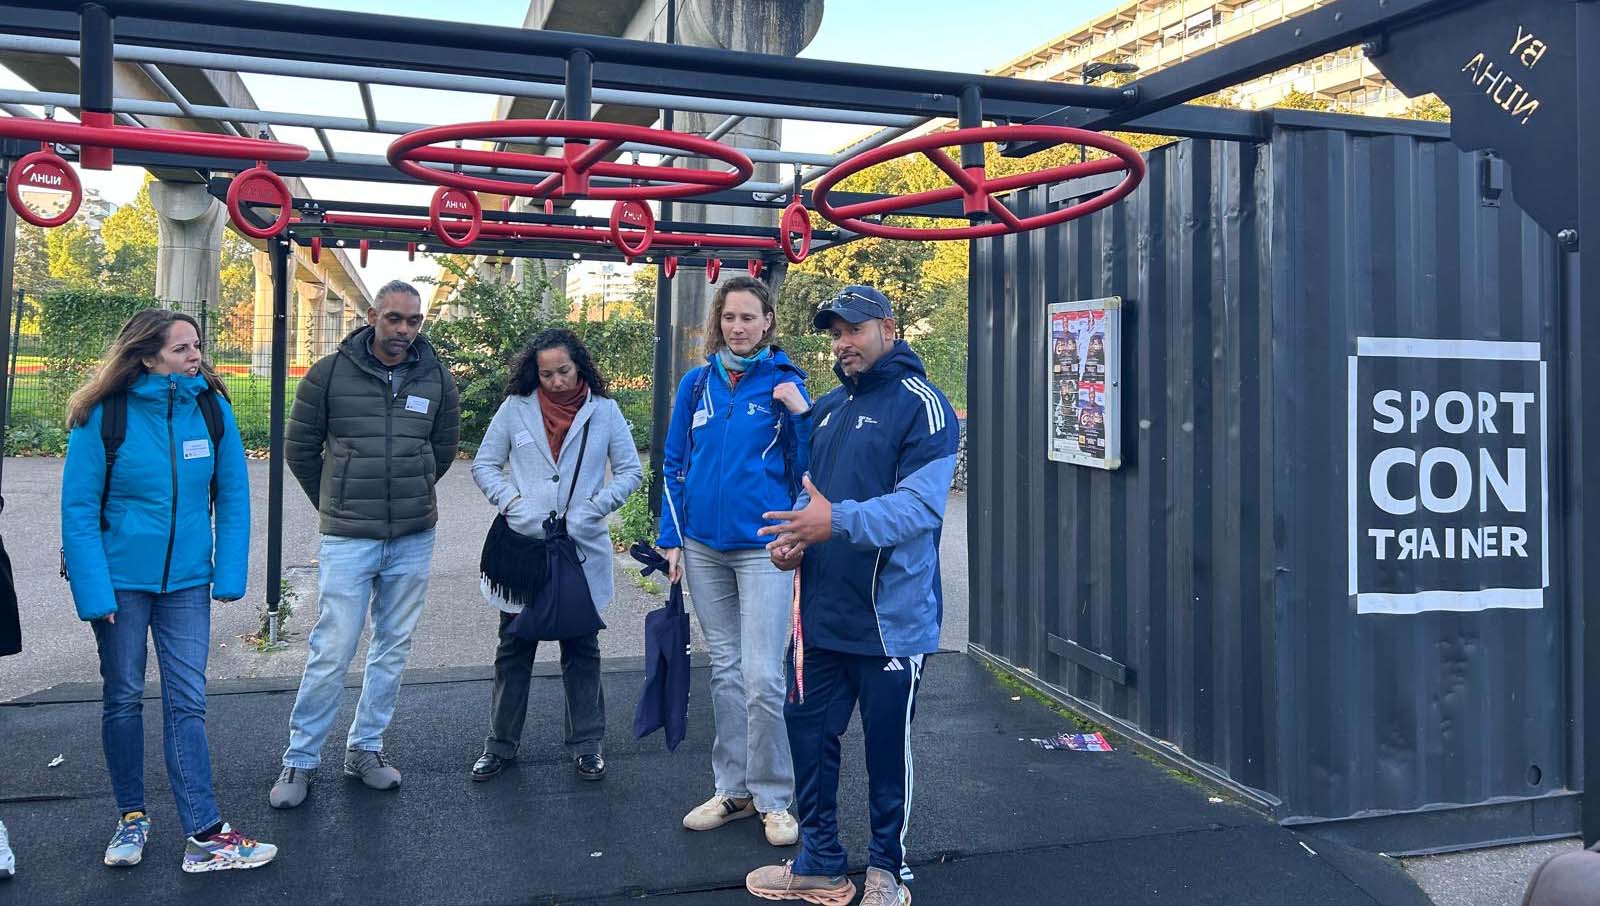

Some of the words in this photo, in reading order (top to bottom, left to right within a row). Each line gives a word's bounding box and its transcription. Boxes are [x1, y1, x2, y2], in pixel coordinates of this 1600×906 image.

[1372, 389, 1535, 434] SPORT
[1369, 446, 1527, 515] CON
[1368, 525, 1529, 560] TRAINER
